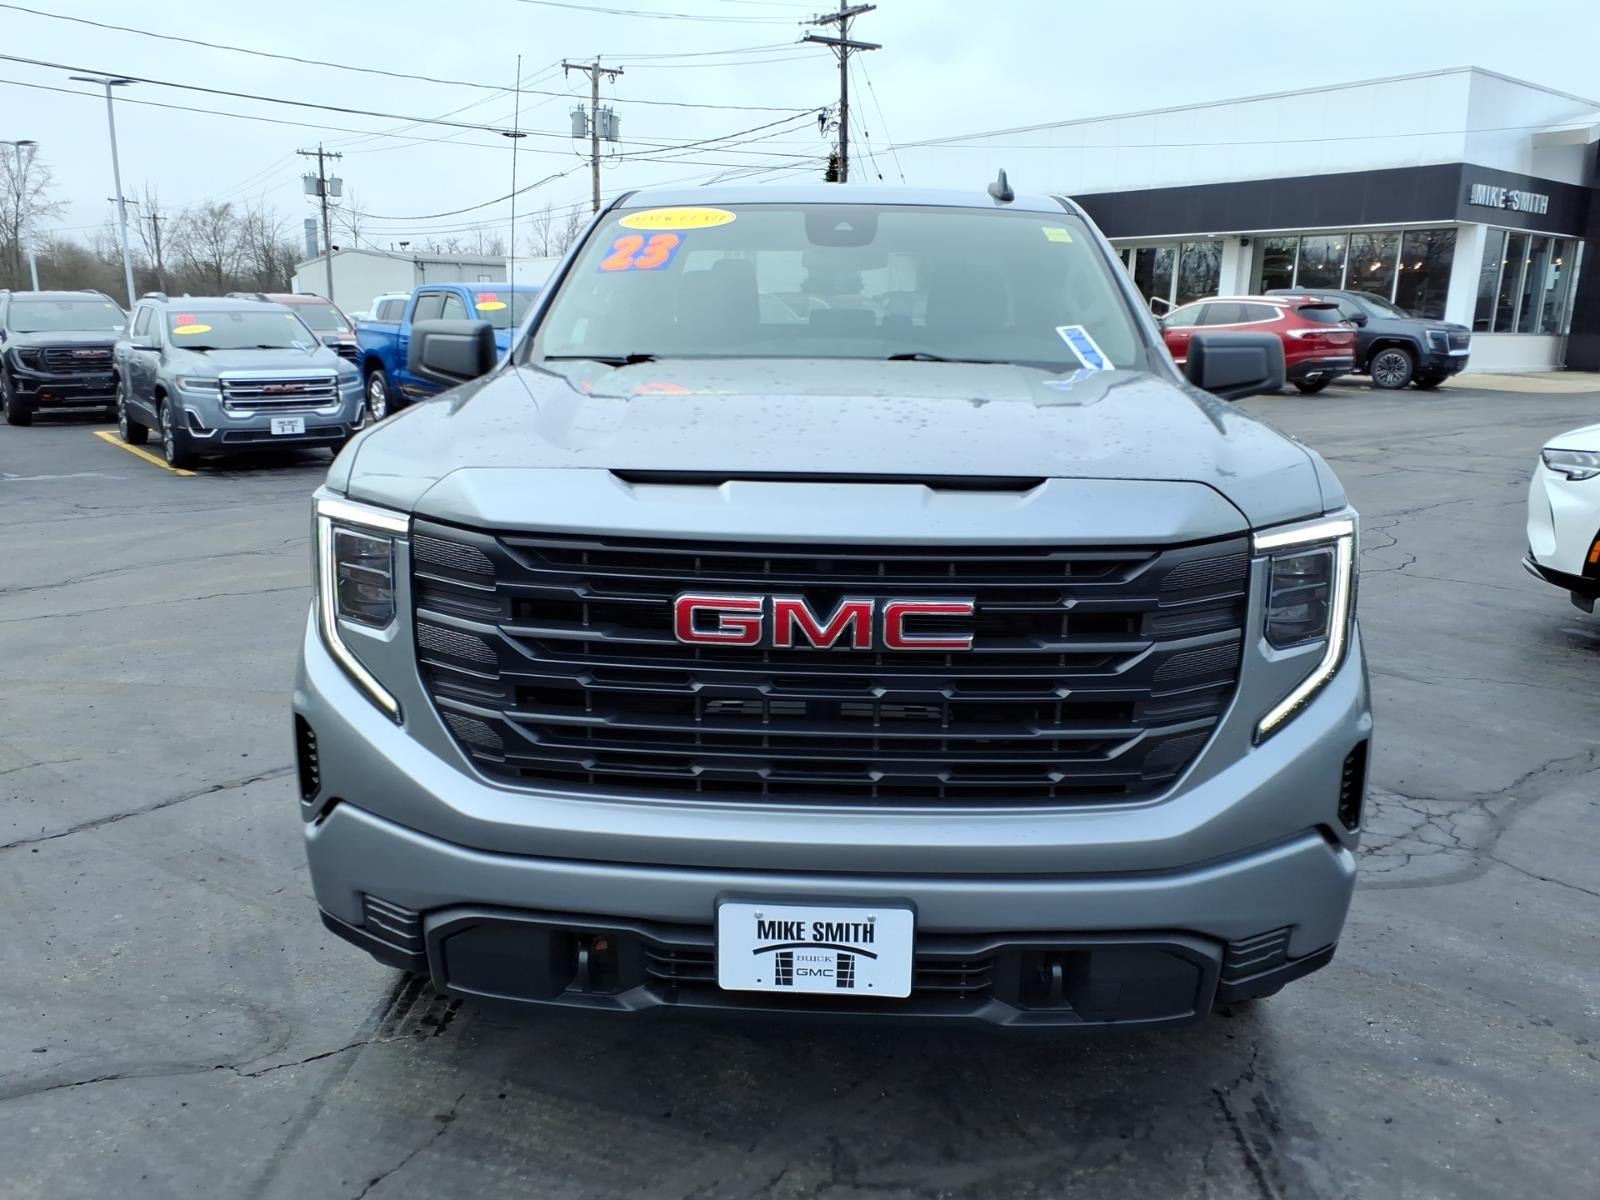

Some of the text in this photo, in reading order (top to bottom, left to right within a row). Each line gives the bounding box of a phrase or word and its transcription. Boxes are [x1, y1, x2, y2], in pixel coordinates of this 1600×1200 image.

[1473, 184, 1549, 215] MIKE SMITH
[599, 233, 680, 271] 23
[673, 592, 976, 650] GMC
[757, 920, 875, 943] MIKE SMITH
[796, 955, 833, 963] BUICK
[796, 968, 834, 978] GMC
